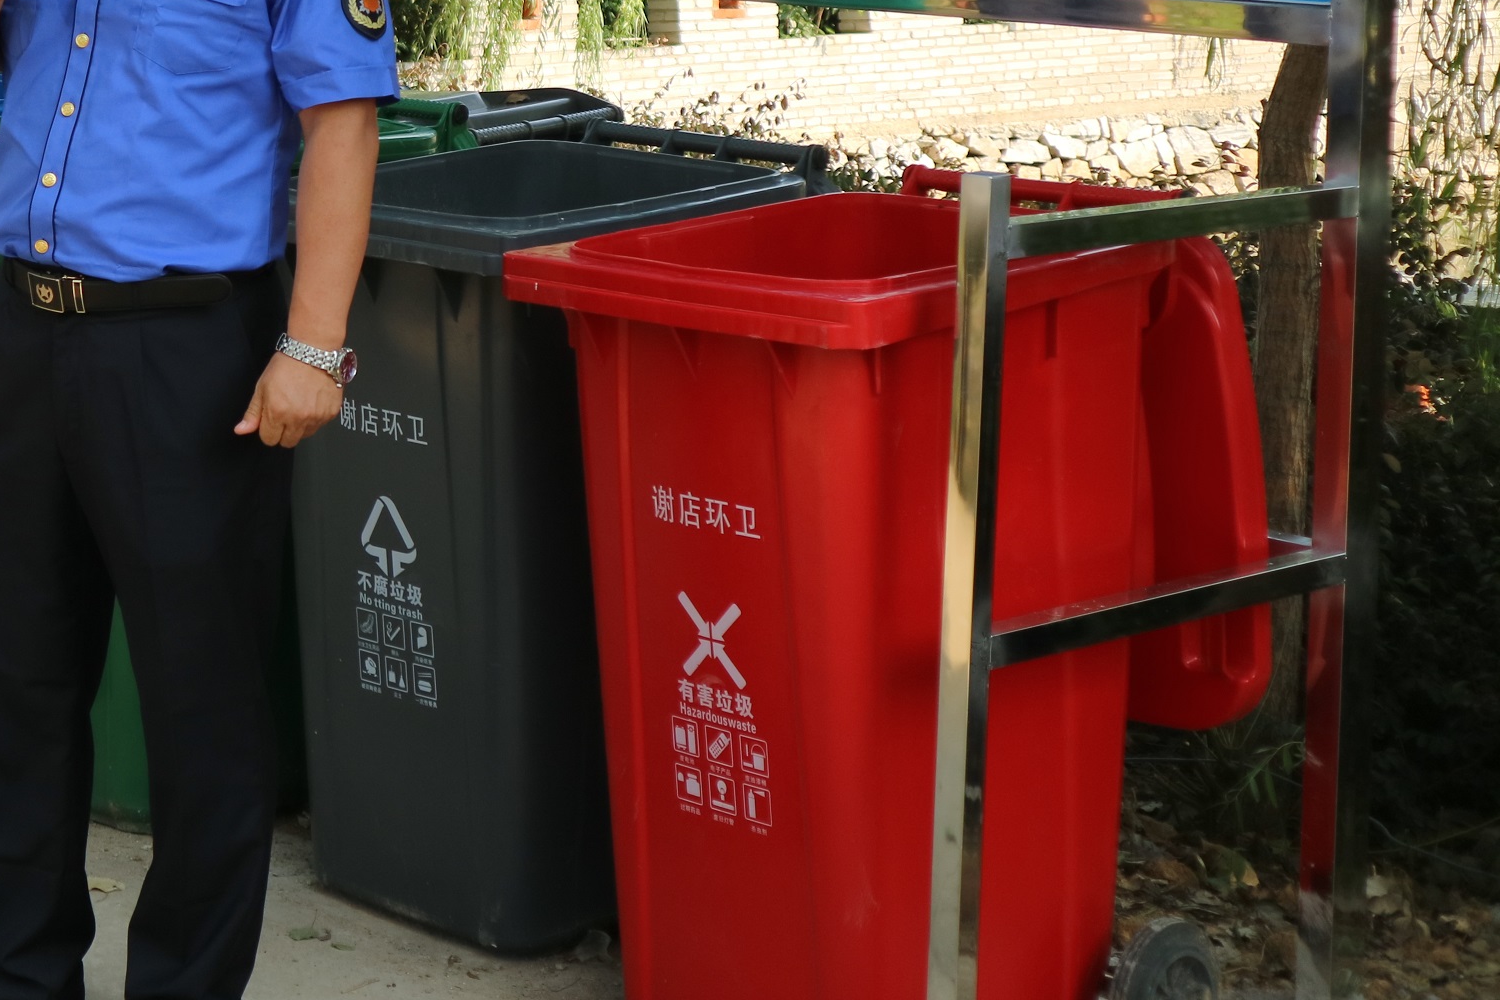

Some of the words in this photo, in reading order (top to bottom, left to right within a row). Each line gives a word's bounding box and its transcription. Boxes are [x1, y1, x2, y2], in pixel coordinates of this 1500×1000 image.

[340, 397, 428, 446] 谢店环卫
[652, 484, 762, 540] 谢店环卫
[357, 570, 423, 608] 不腐垃圾
[398, 605, 423, 621] trash
[677, 678, 755, 720] 有害垃圾
[679, 701, 757, 735] Hazardouswaste
